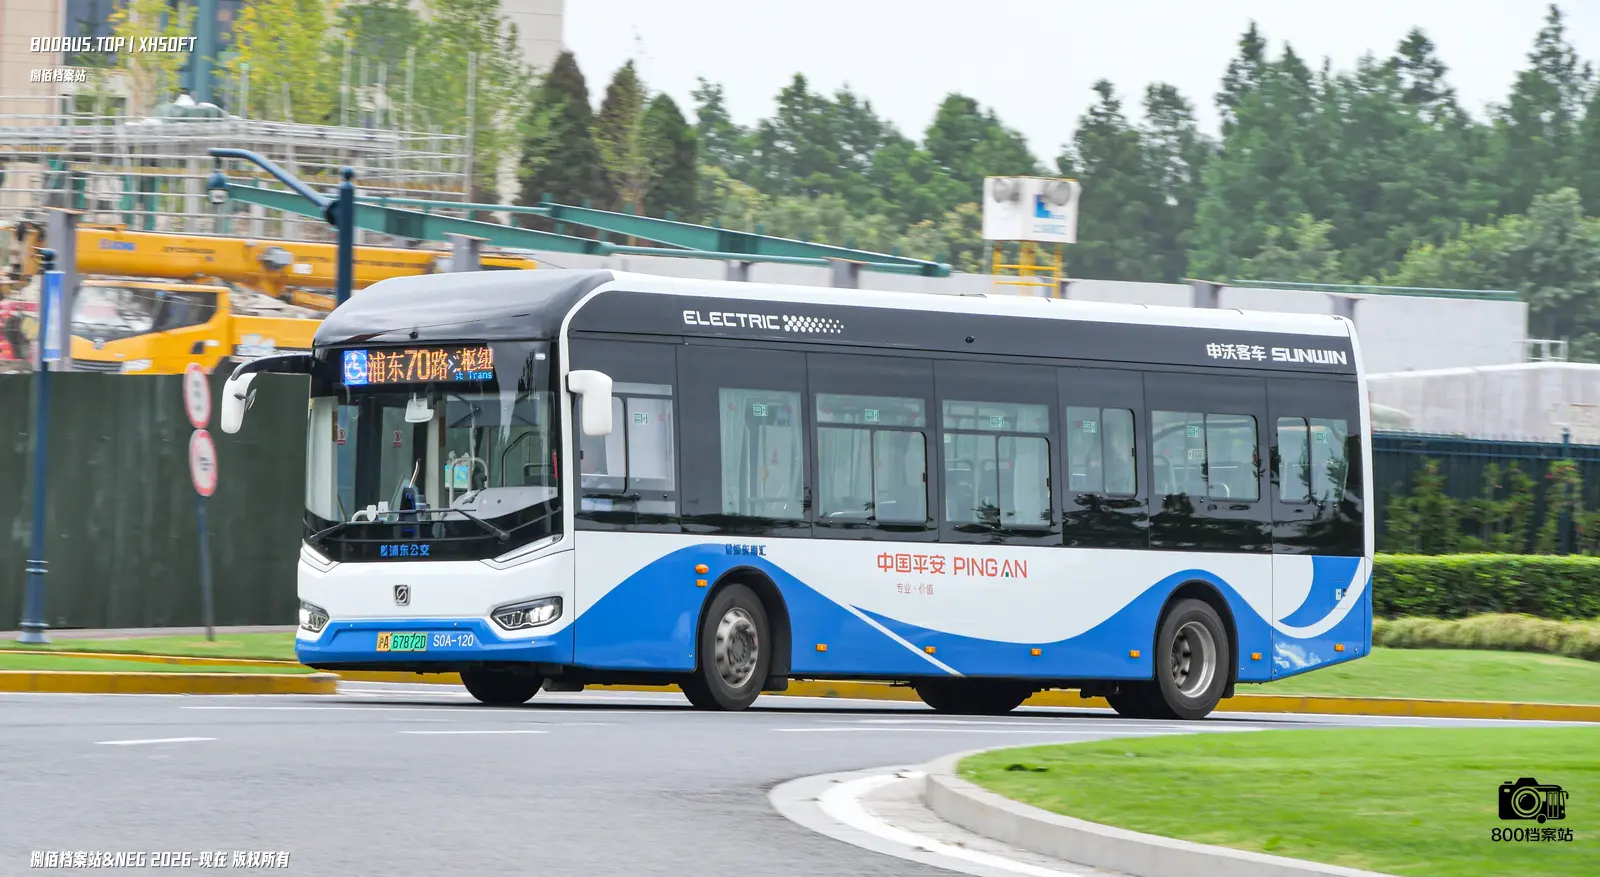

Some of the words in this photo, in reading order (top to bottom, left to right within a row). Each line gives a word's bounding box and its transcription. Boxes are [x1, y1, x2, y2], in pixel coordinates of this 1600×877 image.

[683, 310, 780, 330] ELECTRIC
[1206, 343, 1267, 361] 申沃客车
[1271, 347, 1348, 365] SUNWIN
[368, 349, 449, 383] 浦东70路
[469, 370, 493, 380] Trans
[389, 544, 430, 557] 浦东公交
[877, 552, 946, 574] 中国平安
[953, 557, 1028, 578] PINGAN
